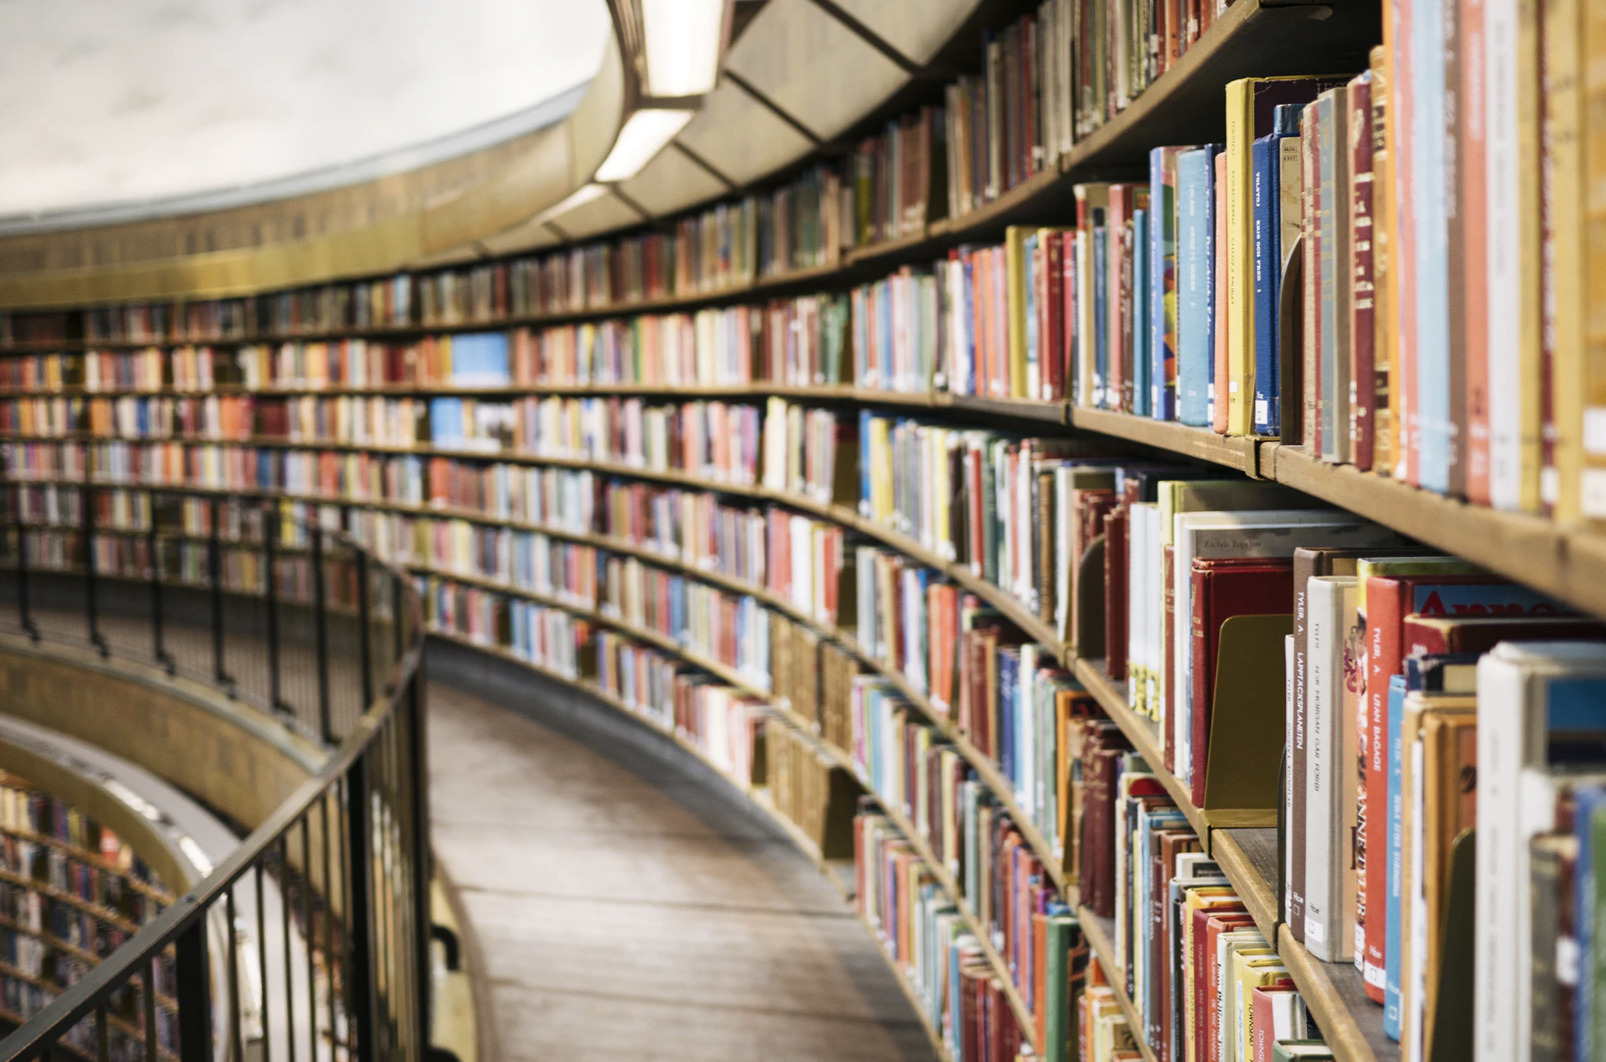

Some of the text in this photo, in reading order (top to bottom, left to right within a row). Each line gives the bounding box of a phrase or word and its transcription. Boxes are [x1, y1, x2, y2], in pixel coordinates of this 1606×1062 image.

[1297, 625, 1304, 635] A.
[1296, 652, 1304, 749] LAPPTÄCKSPLANETEN
[1372, 627, 1381, 771] TYLER, A. UTAN BAGAGE
[1357, 785, 1367, 916] ANNE TYLER
